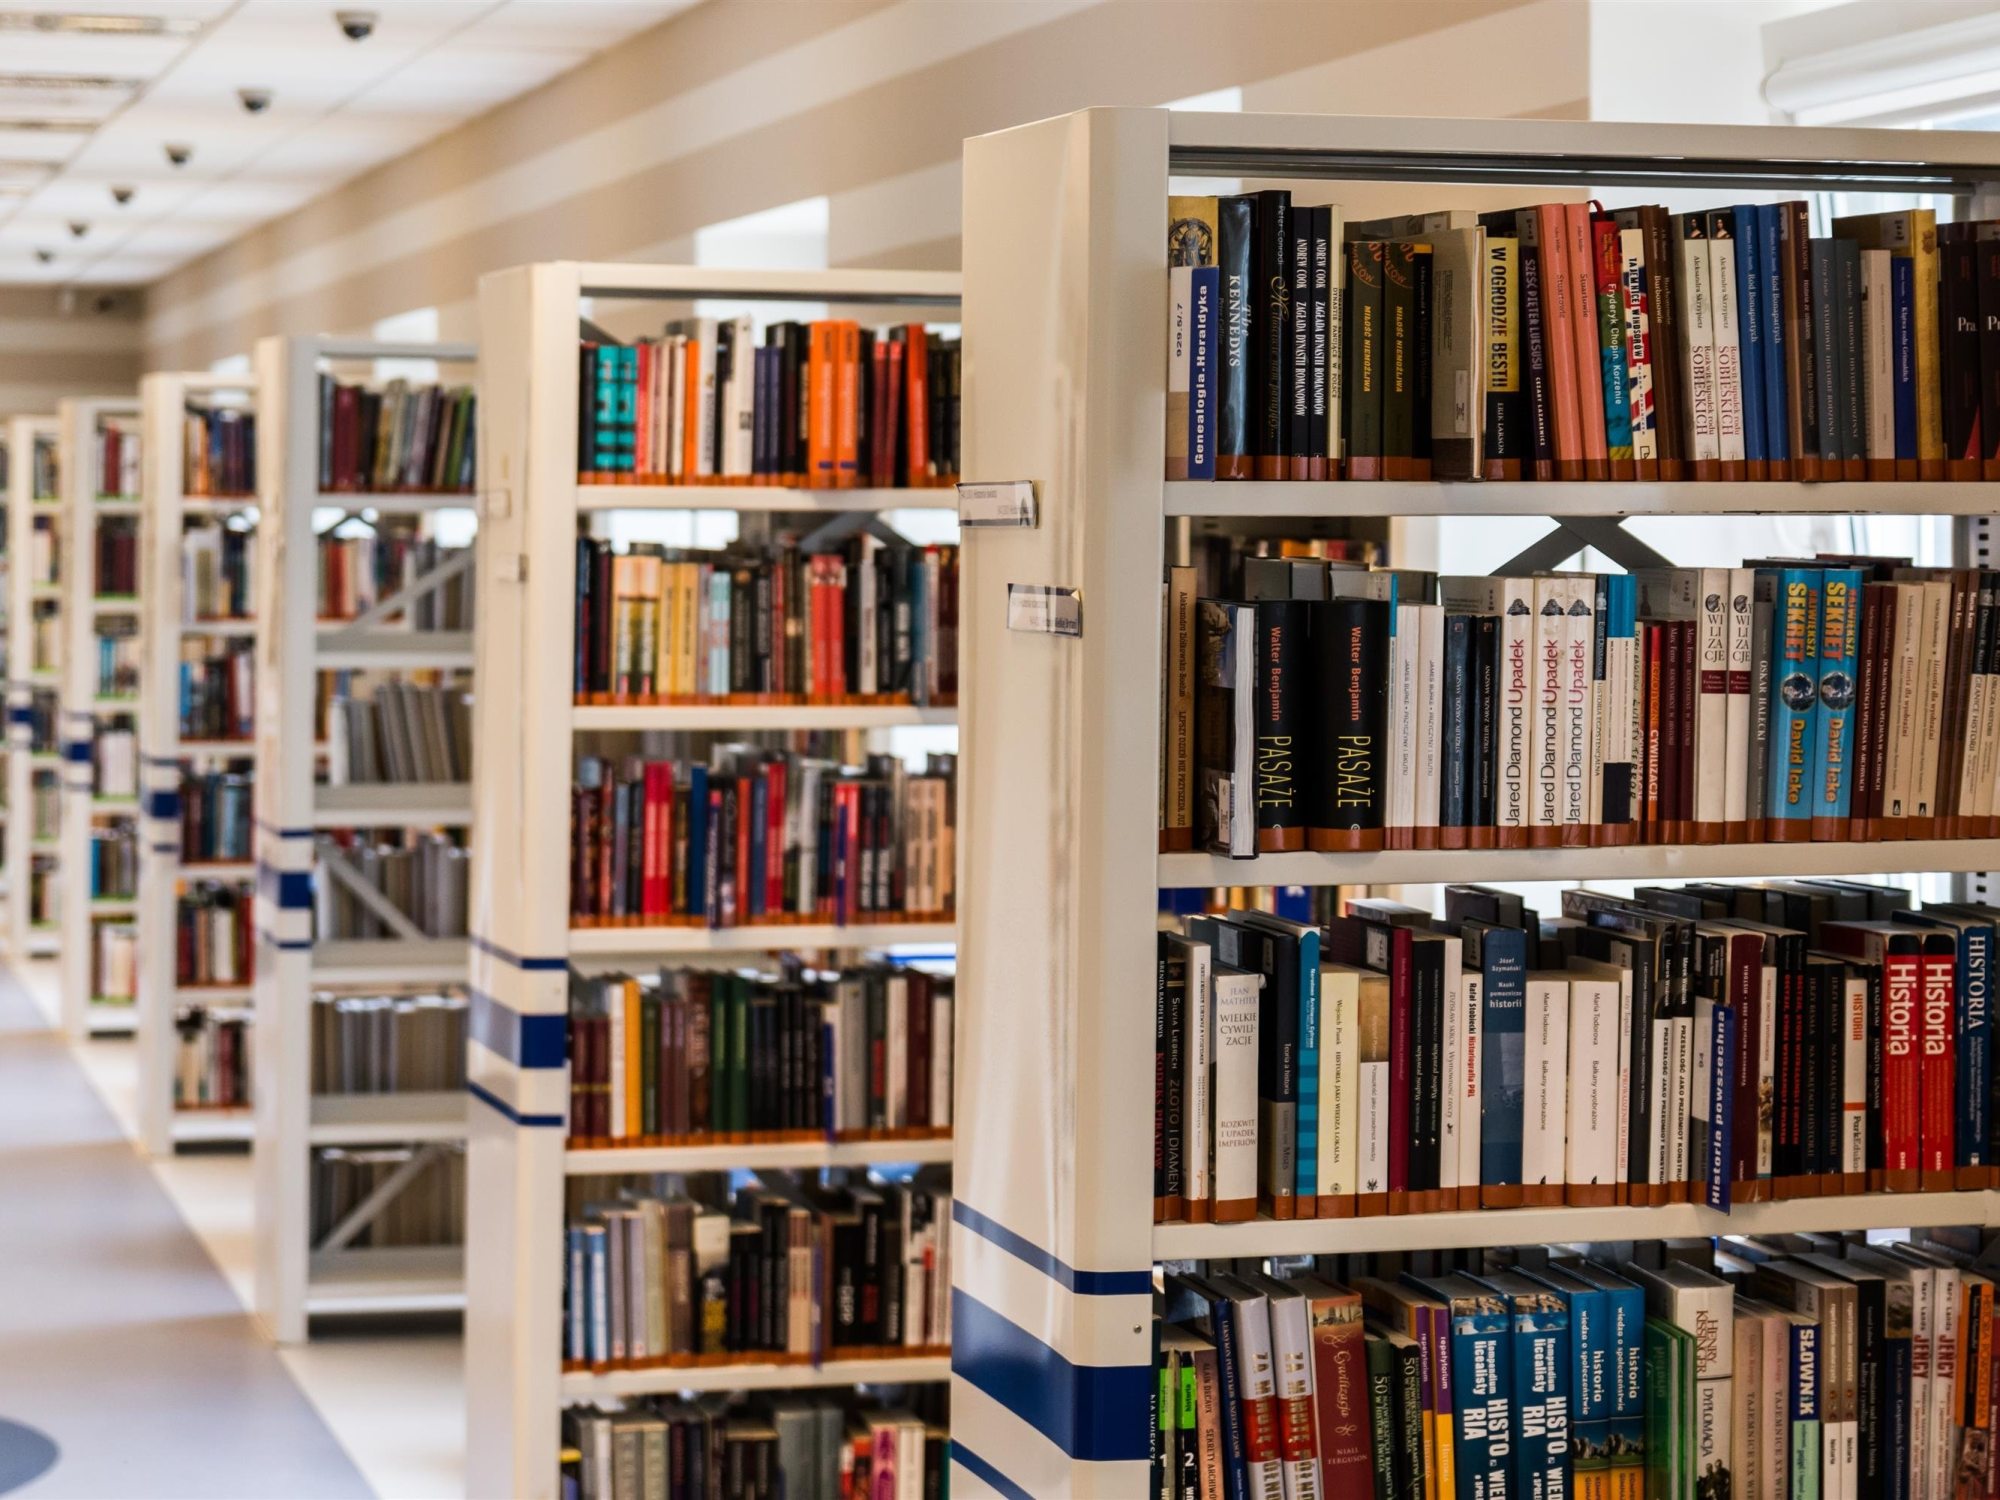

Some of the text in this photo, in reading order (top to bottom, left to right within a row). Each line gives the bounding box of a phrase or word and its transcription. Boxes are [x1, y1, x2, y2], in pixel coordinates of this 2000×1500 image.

[1296, 237, 1308, 289] ANDREW COOK
[1315, 237, 1327, 289] ANDREW COOK
[1628, 257, 1640, 303] TAJEMNICE
[1229, 274, 1241, 367] KENNEDYS
[1241, 303, 1252, 337] The
[1491, 246, 1509, 388] W OGRODZIE BESTII
[1606, 283, 1621, 325] Fryderyk
[1654, 275, 1664, 324] Burbonowie
[1746, 291, 1759, 343] Bonapartych
[1770, 293, 1782, 344] Bonapartych
[1295, 301, 1309, 417] ZAGŁADA DYNASTII ROMANOWÓW
[1313, 301, 1327, 416] ZAGŁADA DYNASTII ROMANOWÓW
[1530, 328, 1543, 370] LUKSUSU
[1631, 309, 1644, 357] WINDSORÓW
[1193, 284, 1209, 465] Genealogia.Heraldyka
[1363, 339, 1372, 392] NIEMOŻLIWA
[1395, 339, 1404, 393] NIEMOŻLIWA
[1613, 364, 1624, 405] Korzenie
[1691, 345, 1708, 436] SOBIESKICH
[1718, 345, 1734, 436] SOBIESKICH
[1497, 402, 1505, 421] ERIK
[1707, 614, 1724, 625] WI
[1707, 638, 1723, 649] ZA
[1709, 626, 1722, 637] LI
[1735, 614, 1750, 625] WI
[1735, 639, 1750, 650] ZA
[1738, 627, 1749, 638] LI
[1784, 582, 1807, 662] SEKRET
[1823, 581, 1847, 662] SEKRET
[1269, 626, 1283, 721] Walter Benjamin
[1348, 626, 1362, 721] Walter Benjamin
[1704, 650, 1726, 662] CJE
[1732, 651, 1751, 664] CJE
[1904, 656, 1914, 686] Historia
[1931, 659, 1940, 689] Historia
[1757, 659, 1769, 741] OSKAR HALECKI
[1968, 675, 1982, 752] GRANICE HISTORII
[1986, 676, 1998, 737] OBLICZA HISTORII
[1505, 639, 1527, 827] Jared Diamond Upadek
[1540, 639, 1561, 827] Jared Diamond Upadek
[1566, 639, 1588, 824] Jared Diamond Upadek
[1259, 735, 1297, 809] PASAŻE
[1338, 735, 1376, 808] PASAŻE
[1648, 729, 1659, 801] CYWILIZACJE
[1787, 718, 1806, 805] David Icke
[1824, 717, 1844, 803] David Icke
[1157, 960, 1166, 990] BRENDA
[1230, 987, 1249, 996] JEAN
[1491, 965, 1522, 973] Szymański
[1968, 935, 1986, 1030] HISTORIA
[1220, 1012, 1257, 1023] WIELKIE
[1220, 1024, 1256, 1035] CYWILI-
[1489, 999, 1522, 1008] historii
[1852, 993, 1864, 1041] HISTORIA
[1889, 963, 1917, 1055] Historia
[1924, 963, 1953, 1055] Historia
[1171, 997, 1181, 1070] SILVIA LIEBRICH
[1225, 1036, 1252, 1046] ZACJE
[1466, 982, 1478, 1098] Rafał Stobiecki Historiografia PRL
[1283, 1042, 1292, 1095] Teoria historia
[1540, 992, 1550, 1131] Maria Todorova Bałkany wyobrażone
[1590, 992, 1601, 1131] Maria Todorova Bałkany wyobrażone
[1660, 1027, 1670, 1144] PRZESZŁOŚĆ JAKO PRZEDMIOT
[1168, 1079, 1181, 1125] ZŁOTO
[1221, 1119, 1255, 1129] ROZKWIT
[1333, 1051, 1342, 1164] HISTORIA WIEDZA LOKALNA
[1677, 1097, 1685, 1141] PRZEDMIOT
[1711, 1010, 1726, 1205] Historia powszechna
[1218, 1138, 1256, 1148] IMPERIÓW
[1226, 1128, 1256, 1138] UPADEK
[1222, 1320, 1233, 1359] LEKSYKON
[1403, 1357, 1416, 1375] 50
[1420, 1333, 1430, 1382] repetytorium
[1439, 1336, 1450, 1390] repetytorium
[1531, 1338, 1547, 1393] licealisty
[1545, 1337, 1557, 1392] Kompendium
[1580, 1310, 1591, 1416] wiedza społeczeństwie
[1616, 1306, 1626, 1411] wiedza społeczeństwie
[1696, 1310, 1709, 1374] KISSINGER
[1707, 1320, 1719, 1363] HENRY
[1333, 1350, 1352, 1418] Cywilizacja
[1374, 1375, 1388, 1394] 50
[1472, 1340, 1489, 1395] licealisty
[1487, 1339, 1499, 1394] Kompendium
[1593, 1350, 1605, 1403] historia
[1628, 1346, 1641, 1399] historia
[1184, 1383, 1193, 1412] historia
[1203, 1362, 1217, 1461] ALAIN DECAUX SEKRETY
[1462, 1407, 1487, 1441] RIA
[1522, 1405, 1546, 1438] RIA
[1701, 1388, 1714, 1457] DYPLOMACJA
[1774, 1389, 1784, 1456] TAJEMNICE
[1487, 1397, 1510, 1457] HISTO
[1545, 1395, 1568, 1454] HISTO
[1747, 1391, 1756, 1458] TAJEMNICE
[1846, 1437, 1854, 1463] historia
[1184, 1451, 1196, 1468] 2
[1328, 1453, 1368, 1465] FERGUSON
[1336, 1447, 1359, 1456] NIALL
[1829, 1438, 1837, 1465] historia
